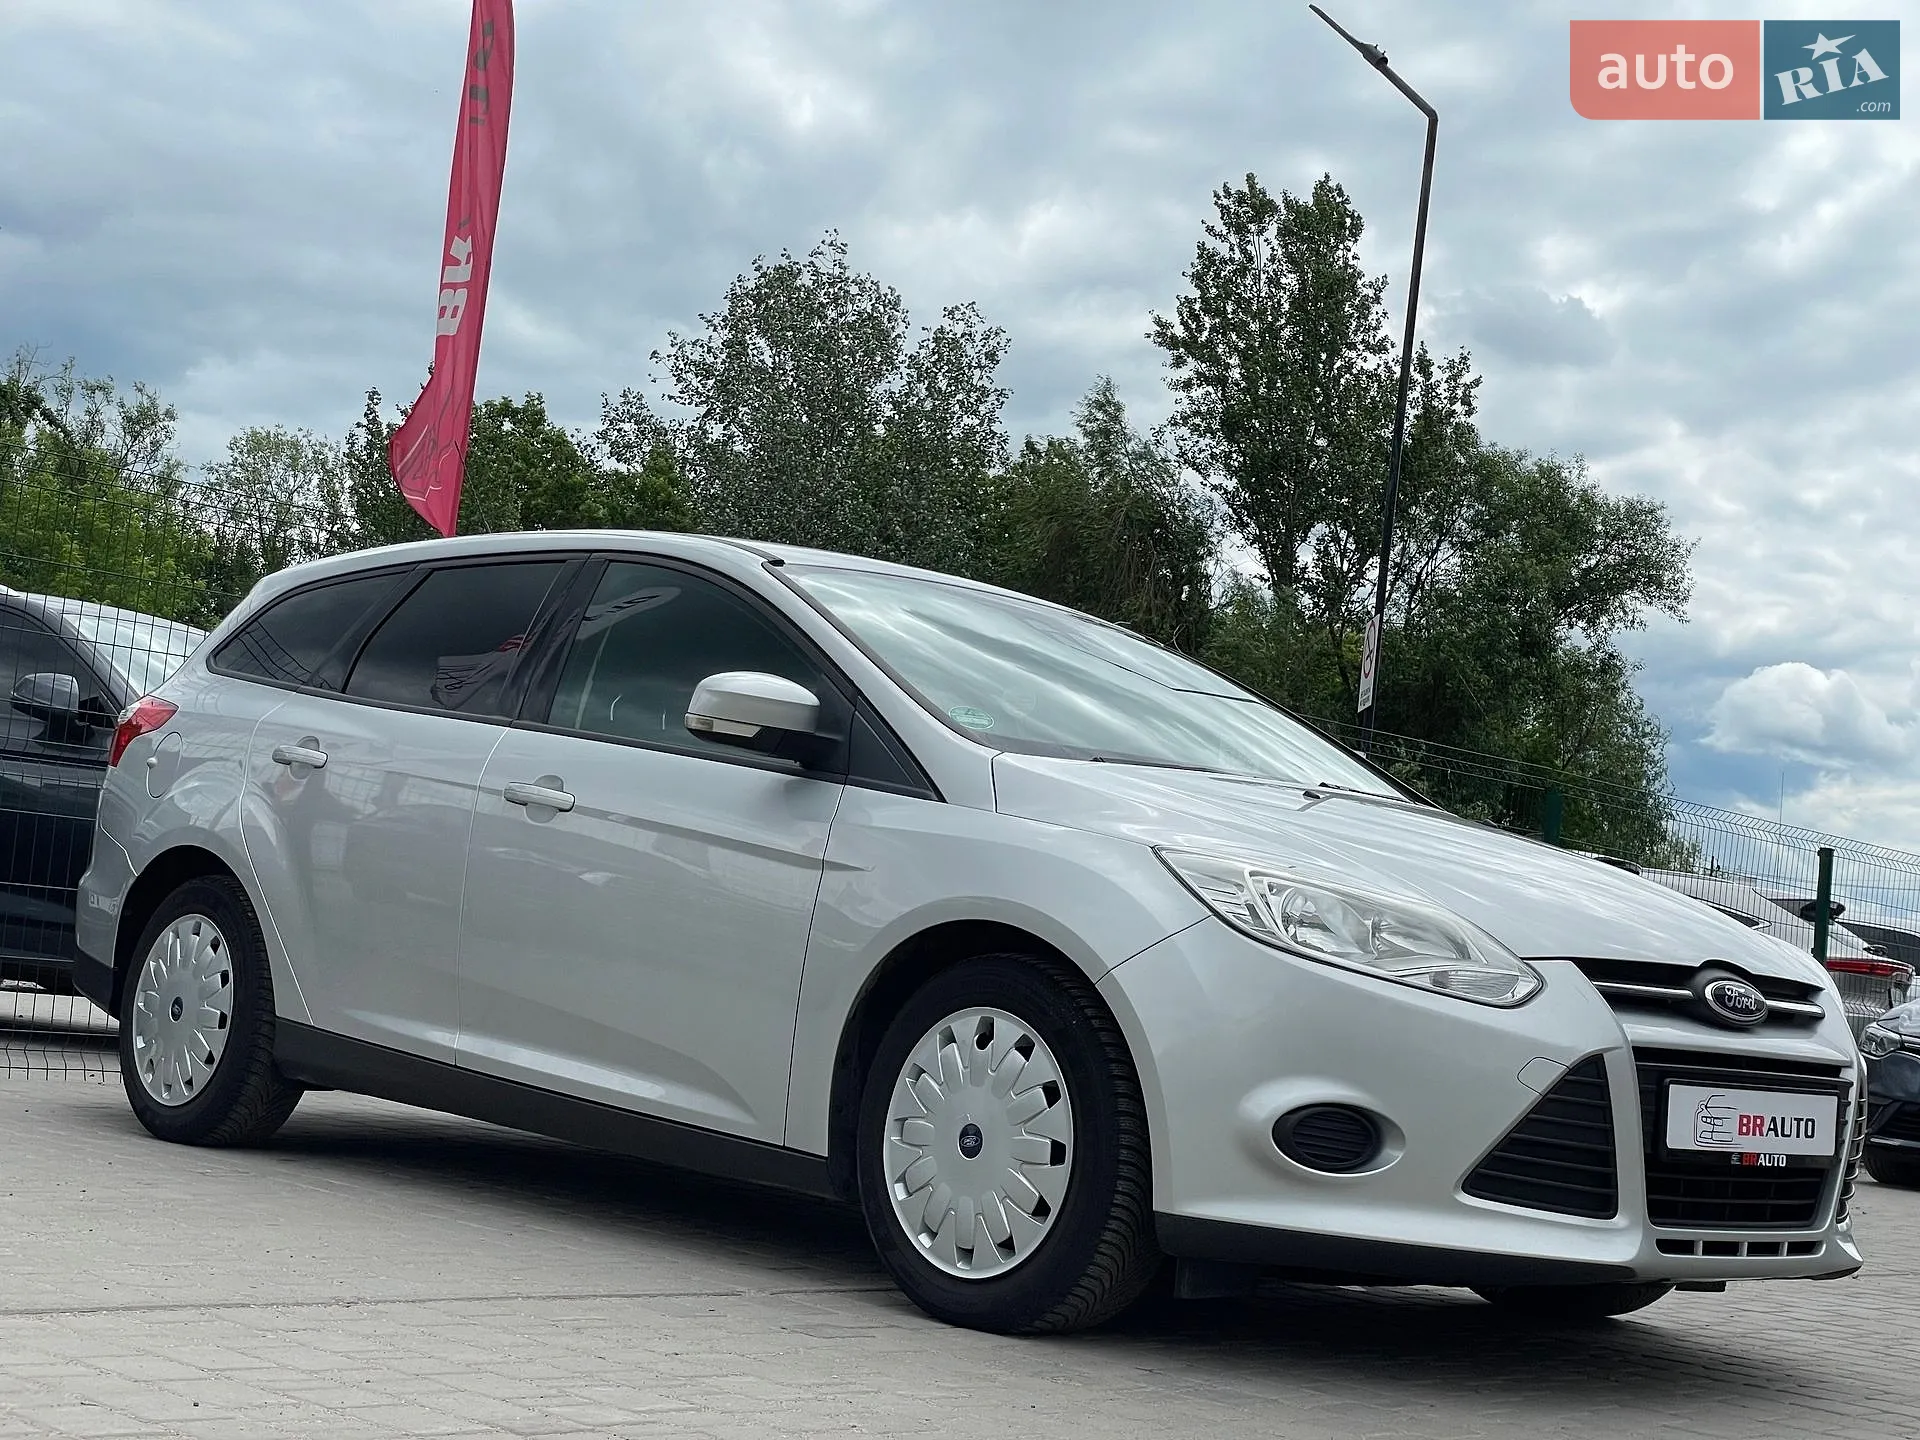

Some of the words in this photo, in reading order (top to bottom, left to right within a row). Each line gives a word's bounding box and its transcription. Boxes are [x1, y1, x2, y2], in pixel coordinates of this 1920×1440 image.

[1724, 984, 1757, 1011] Ford
[1737, 1113, 1816, 1140] BRAUTO
[1742, 1152, 1787, 1167] BRAUTO
